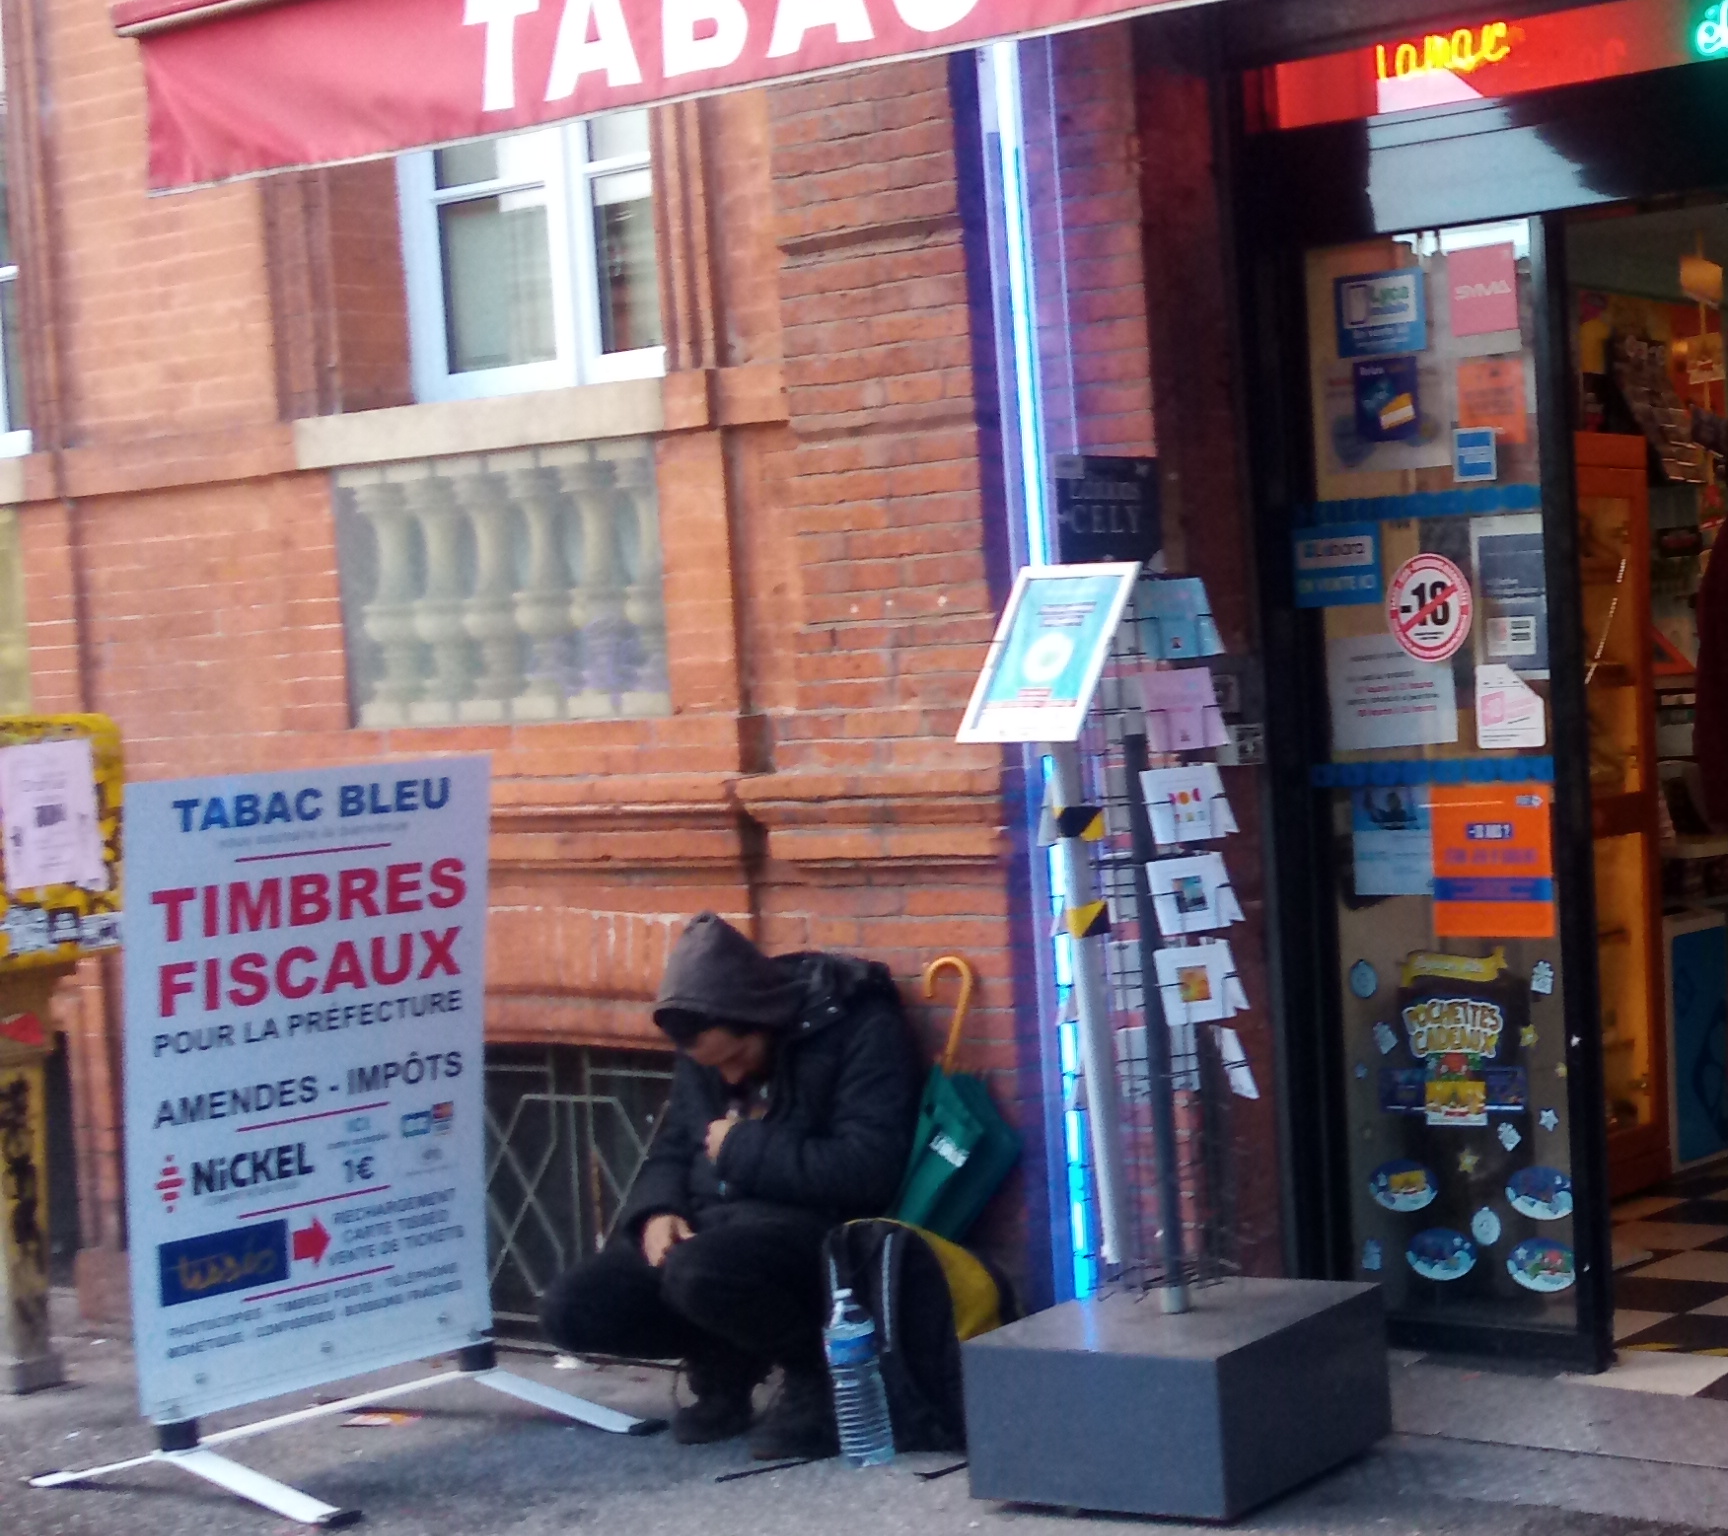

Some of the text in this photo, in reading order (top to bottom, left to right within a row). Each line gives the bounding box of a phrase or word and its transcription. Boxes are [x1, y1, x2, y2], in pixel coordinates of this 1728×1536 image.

[172, 776, 451, 833] TABAC BLEU
[150, 858, 468, 942] TIMBRES
[158, 926, 463, 1017] FISCAUX
[152, 989, 464, 1058] POUR LA PRÉFECTURE
[152, 1075, 319, 1130] AMENDES
[346, 1051, 464, 1097] IMPÔTS
[343, 1155, 375, 1183] 1€
